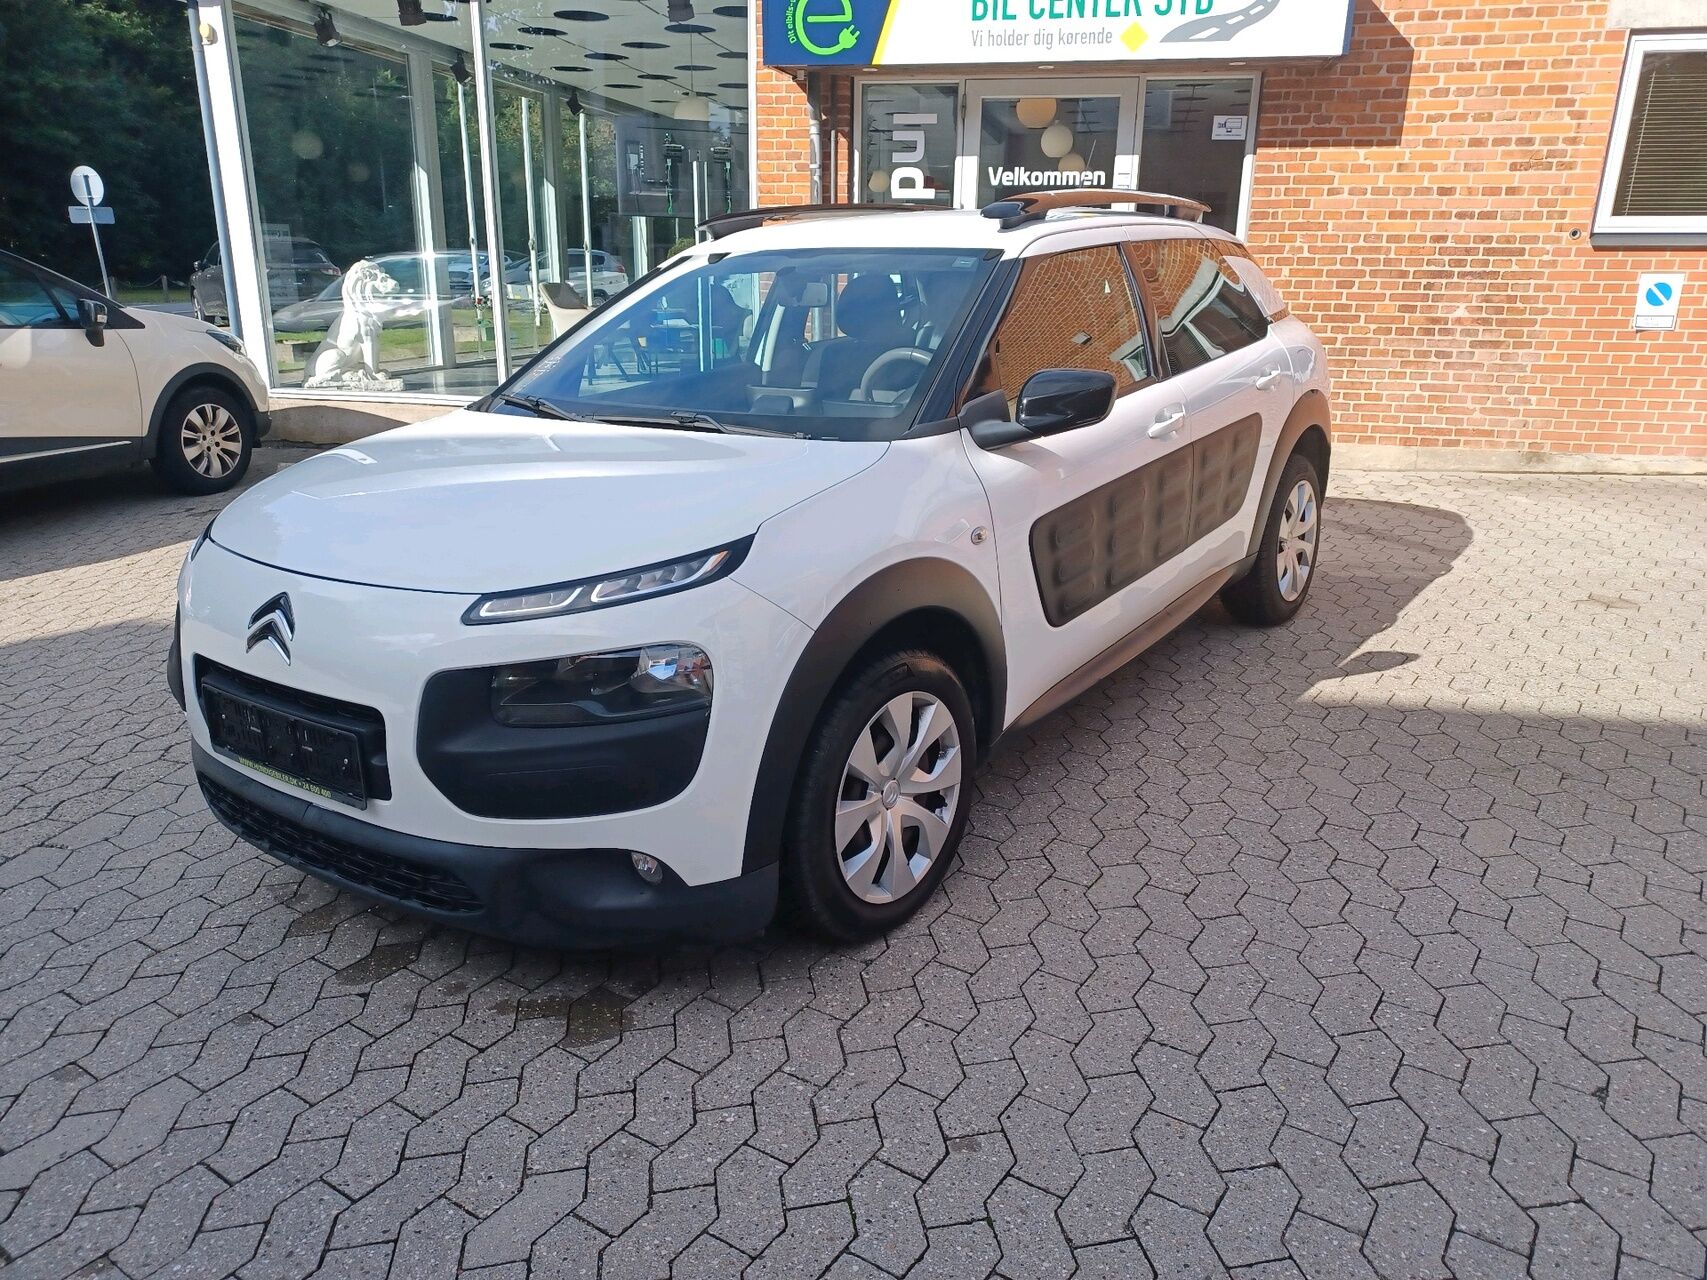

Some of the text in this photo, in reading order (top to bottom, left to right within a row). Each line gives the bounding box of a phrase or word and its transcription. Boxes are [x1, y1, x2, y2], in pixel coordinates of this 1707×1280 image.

[971, 27, 1113, 50] Vi holder dig kørende
[987, 166, 1106, 187] Velkommen
